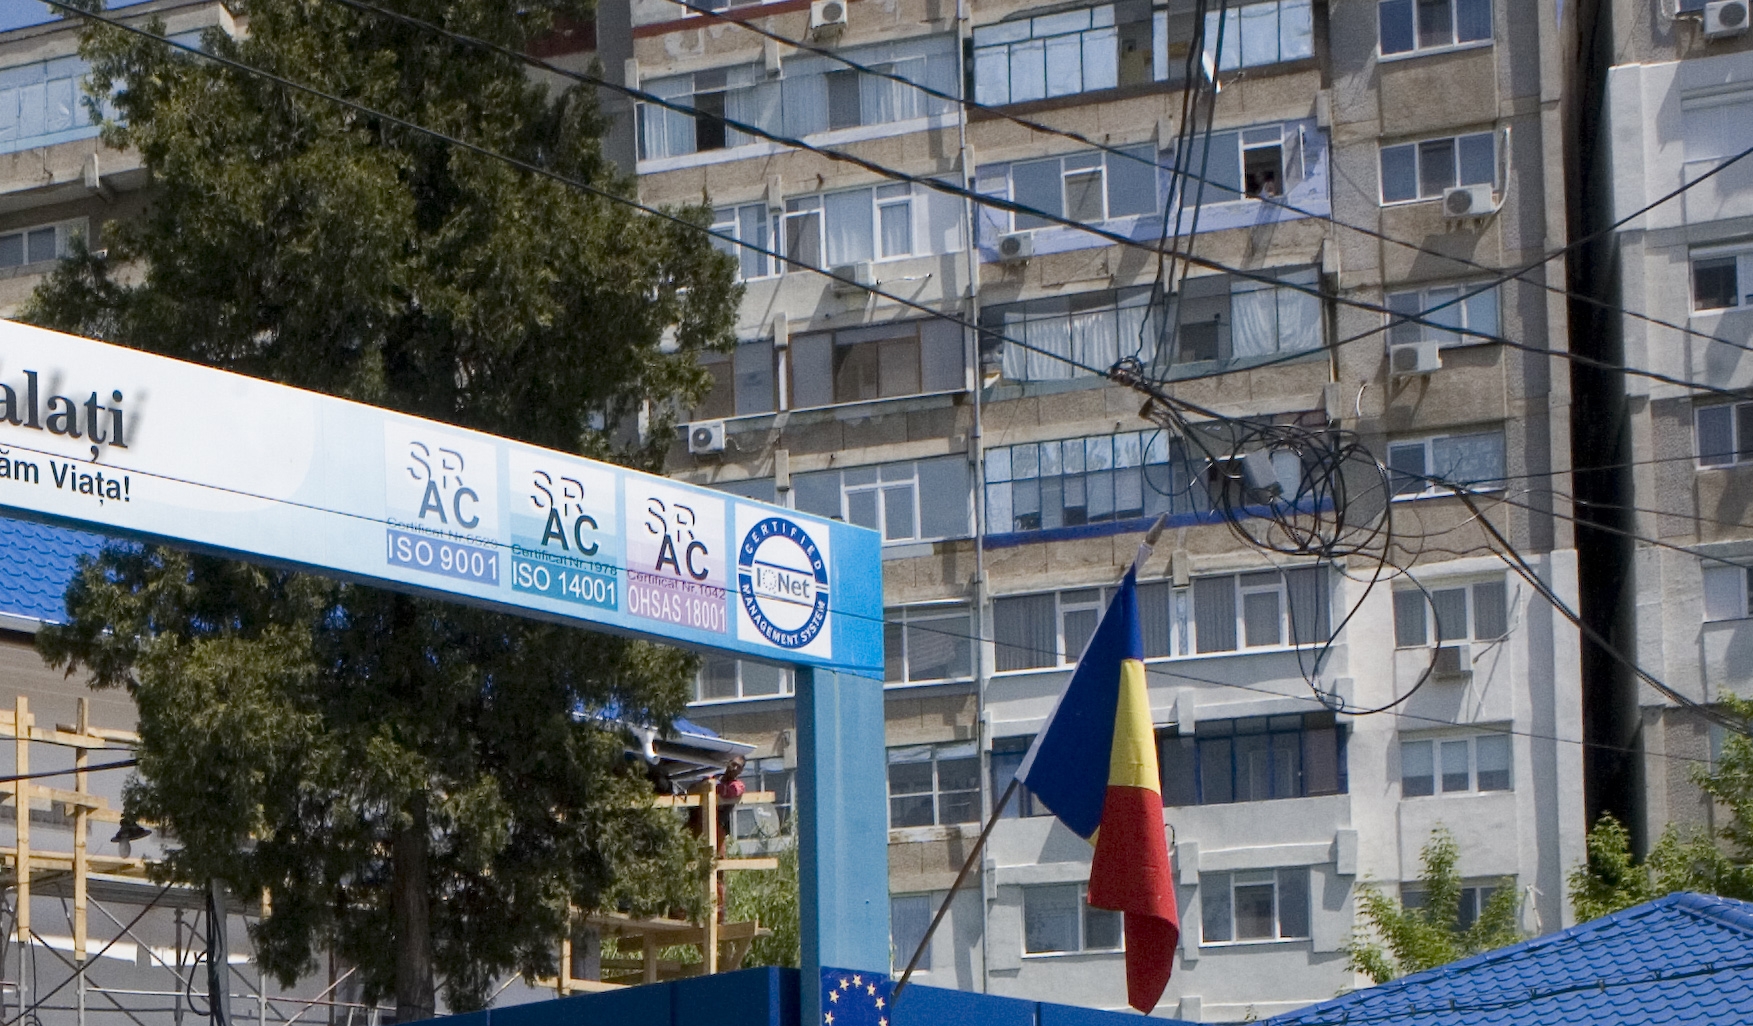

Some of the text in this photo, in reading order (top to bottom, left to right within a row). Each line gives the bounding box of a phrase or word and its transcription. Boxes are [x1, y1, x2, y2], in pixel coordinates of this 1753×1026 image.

[49, 459, 130, 507] Viața!
[418, 479, 480, 529] AC
[541, 507, 599, 556] AC
[745, 521, 822, 570] CERTIFIED
[388, 533, 497, 580] ISO 9001
[628, 570, 678, 590] Certificat
[655, 533, 709, 580] AC
[512, 560, 615, 605] ISO 14001
[628, 585, 726, 632] OHSAS 18001
[742, 583, 826, 646] MANAGEMENT SYSTEM
